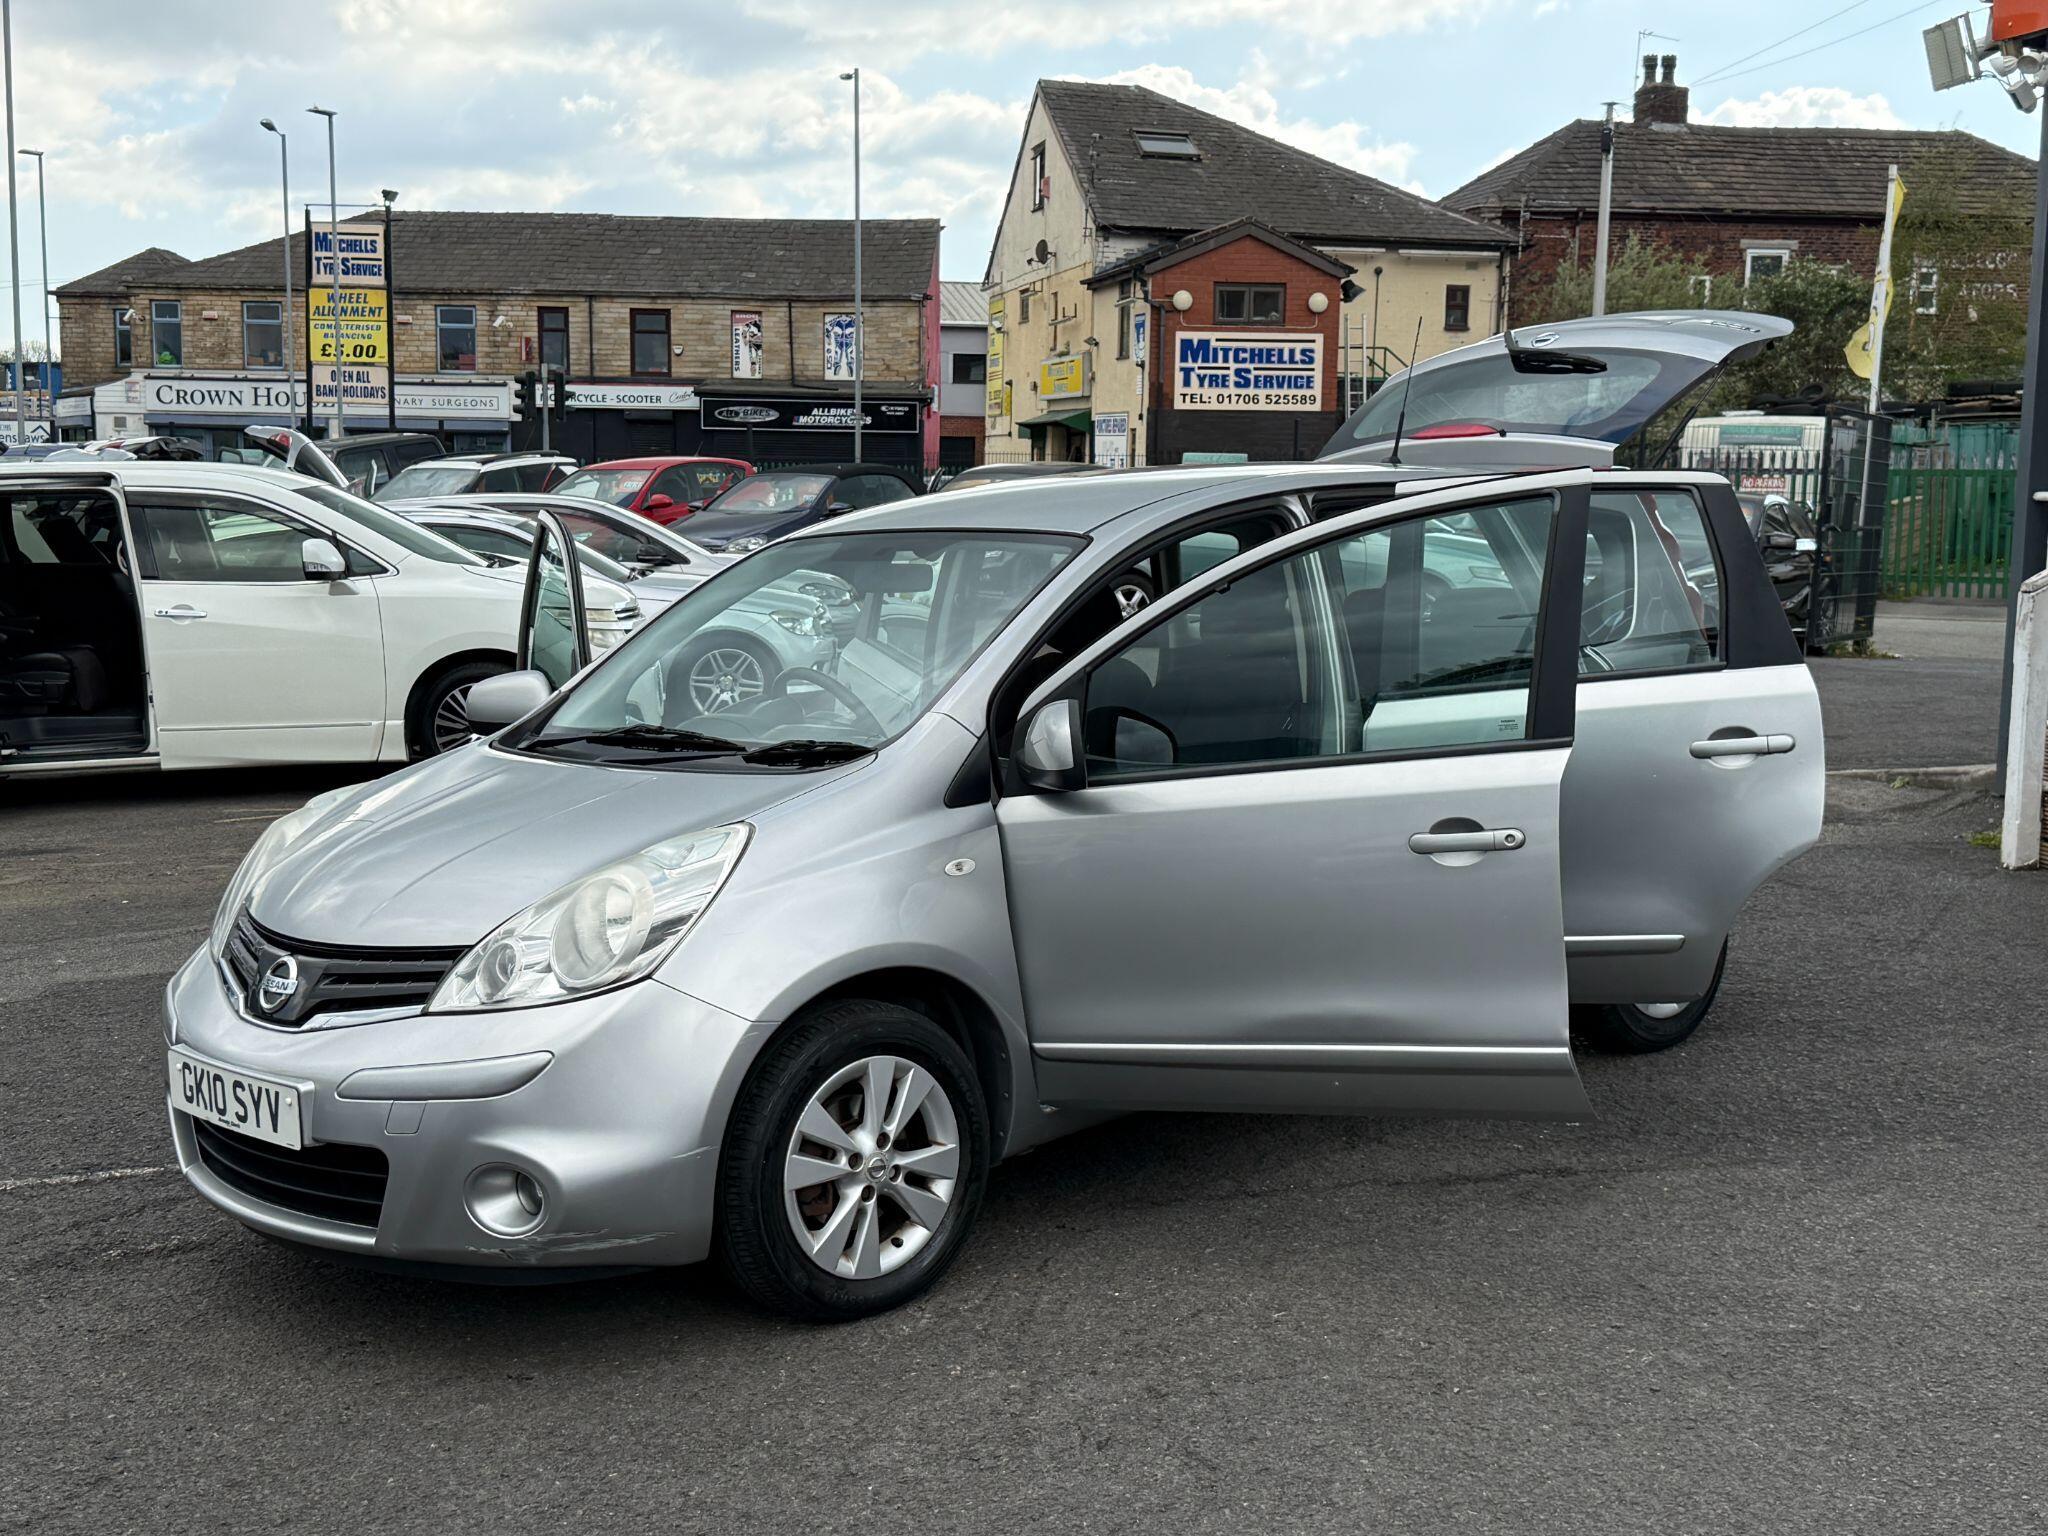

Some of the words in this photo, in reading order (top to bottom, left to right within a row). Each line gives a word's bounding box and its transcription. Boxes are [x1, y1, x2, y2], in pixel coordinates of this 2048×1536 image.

[315, 232, 378, 253] MICHELLS
[315, 256, 339, 275] TYR
[341, 257, 382, 276] SERVICE
[314, 323, 381, 331] COMUTERISED
[1179, 339, 1316, 365] MITCHELLS
[331, 370, 354, 382] OEN
[356, 371, 371, 383] ALL
[1179, 367, 1231, 388] TYRE
[1233, 367, 1315, 389] SERVICE
[156, 385, 244, 405] CROWN
[251, 387, 336, 407] HOU
[343, 385, 387, 399] HOLIDAYS
[432, 398, 495, 408] SURGEONS
[616, 395, 662, 404] SCOOTER
[1180, 393, 1212, 404] TEL:
[1216, 394, 1260, 405] 01706
[1265, 394, 1317, 405] 525589
[743, 409, 770, 417] BIKES
[811, 407, 857, 416] ALLBIKE
[799, 415, 872, 424] MOTORCYCS
[182, 1061, 228, 1117] GK10
[232, 1080, 280, 1133] SYV
